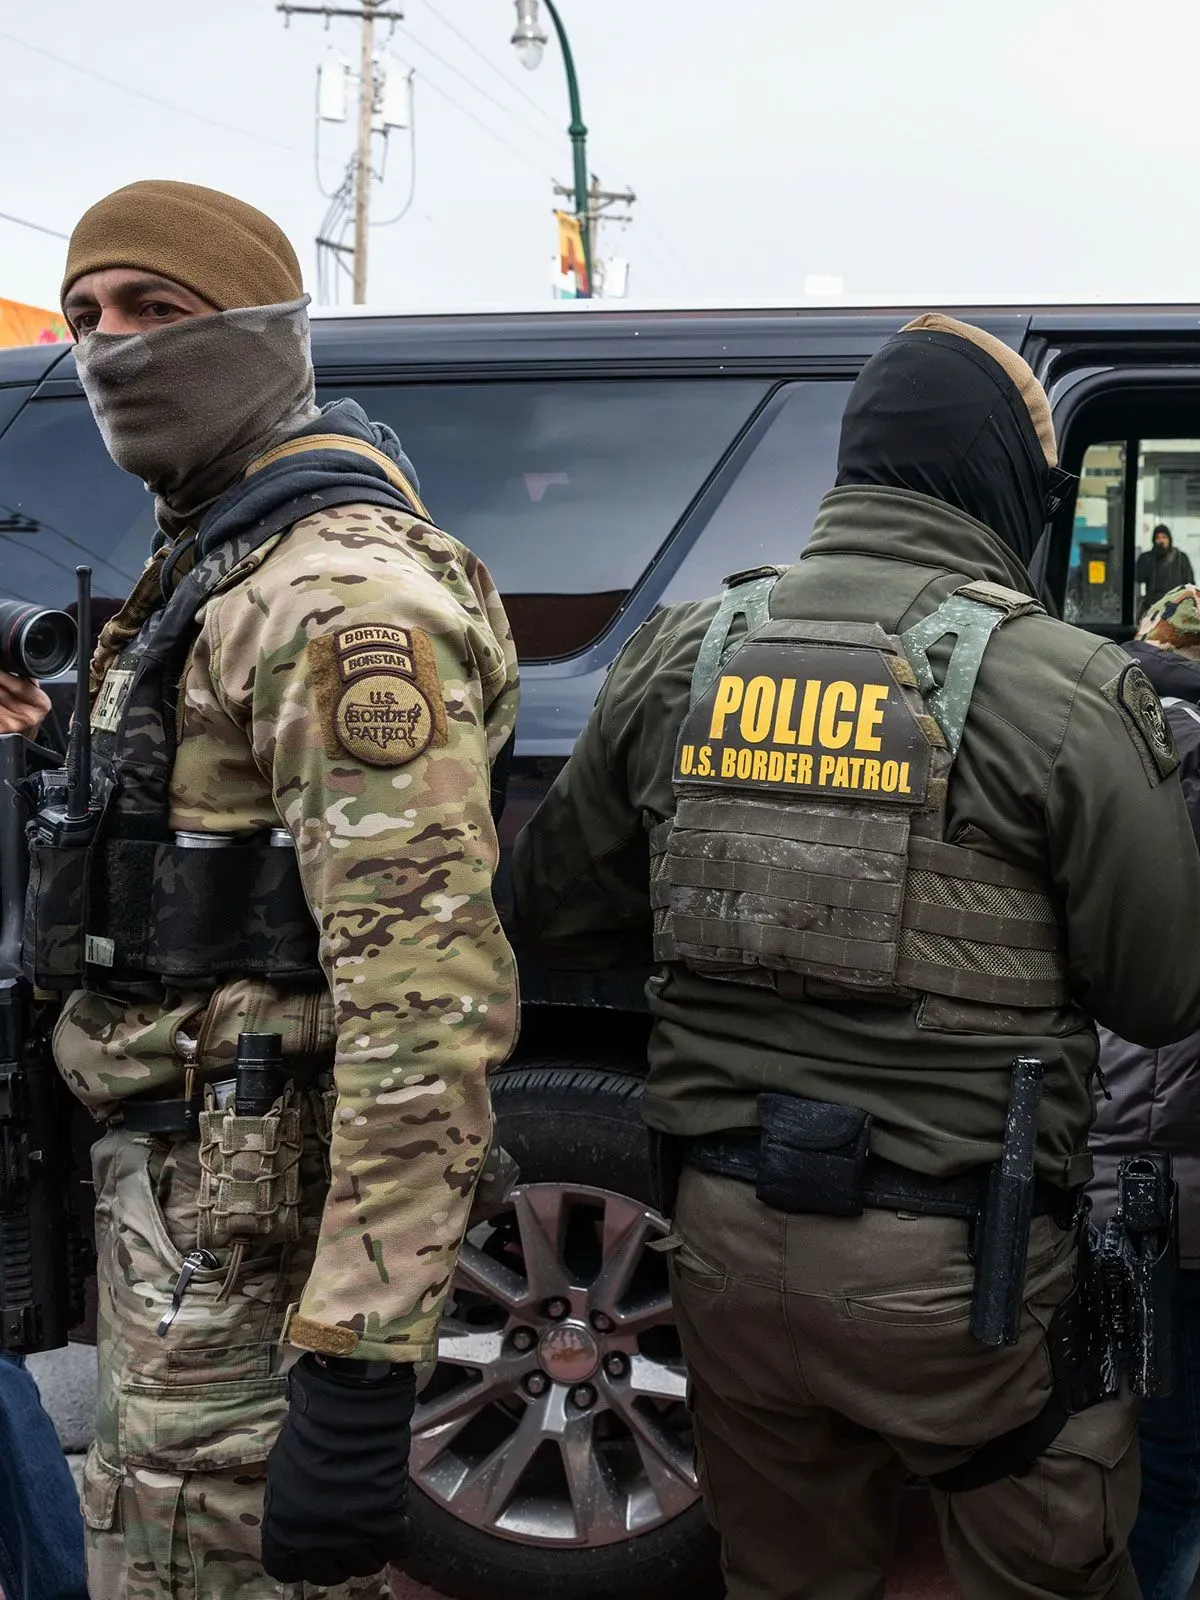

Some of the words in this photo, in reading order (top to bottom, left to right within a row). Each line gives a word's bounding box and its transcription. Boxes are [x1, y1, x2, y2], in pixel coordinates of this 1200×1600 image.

[344, 629, 401, 645] BORTAC
[348, 653, 406, 671] BORSTAR
[347, 708, 419, 724] BORDER
[709, 675, 889, 752] POLICE
[350, 725, 417, 744] PATROL
[680, 744, 716, 777] U.S.
[721, 747, 813, 785] BORDER
[818, 755, 912, 794] PATROL
